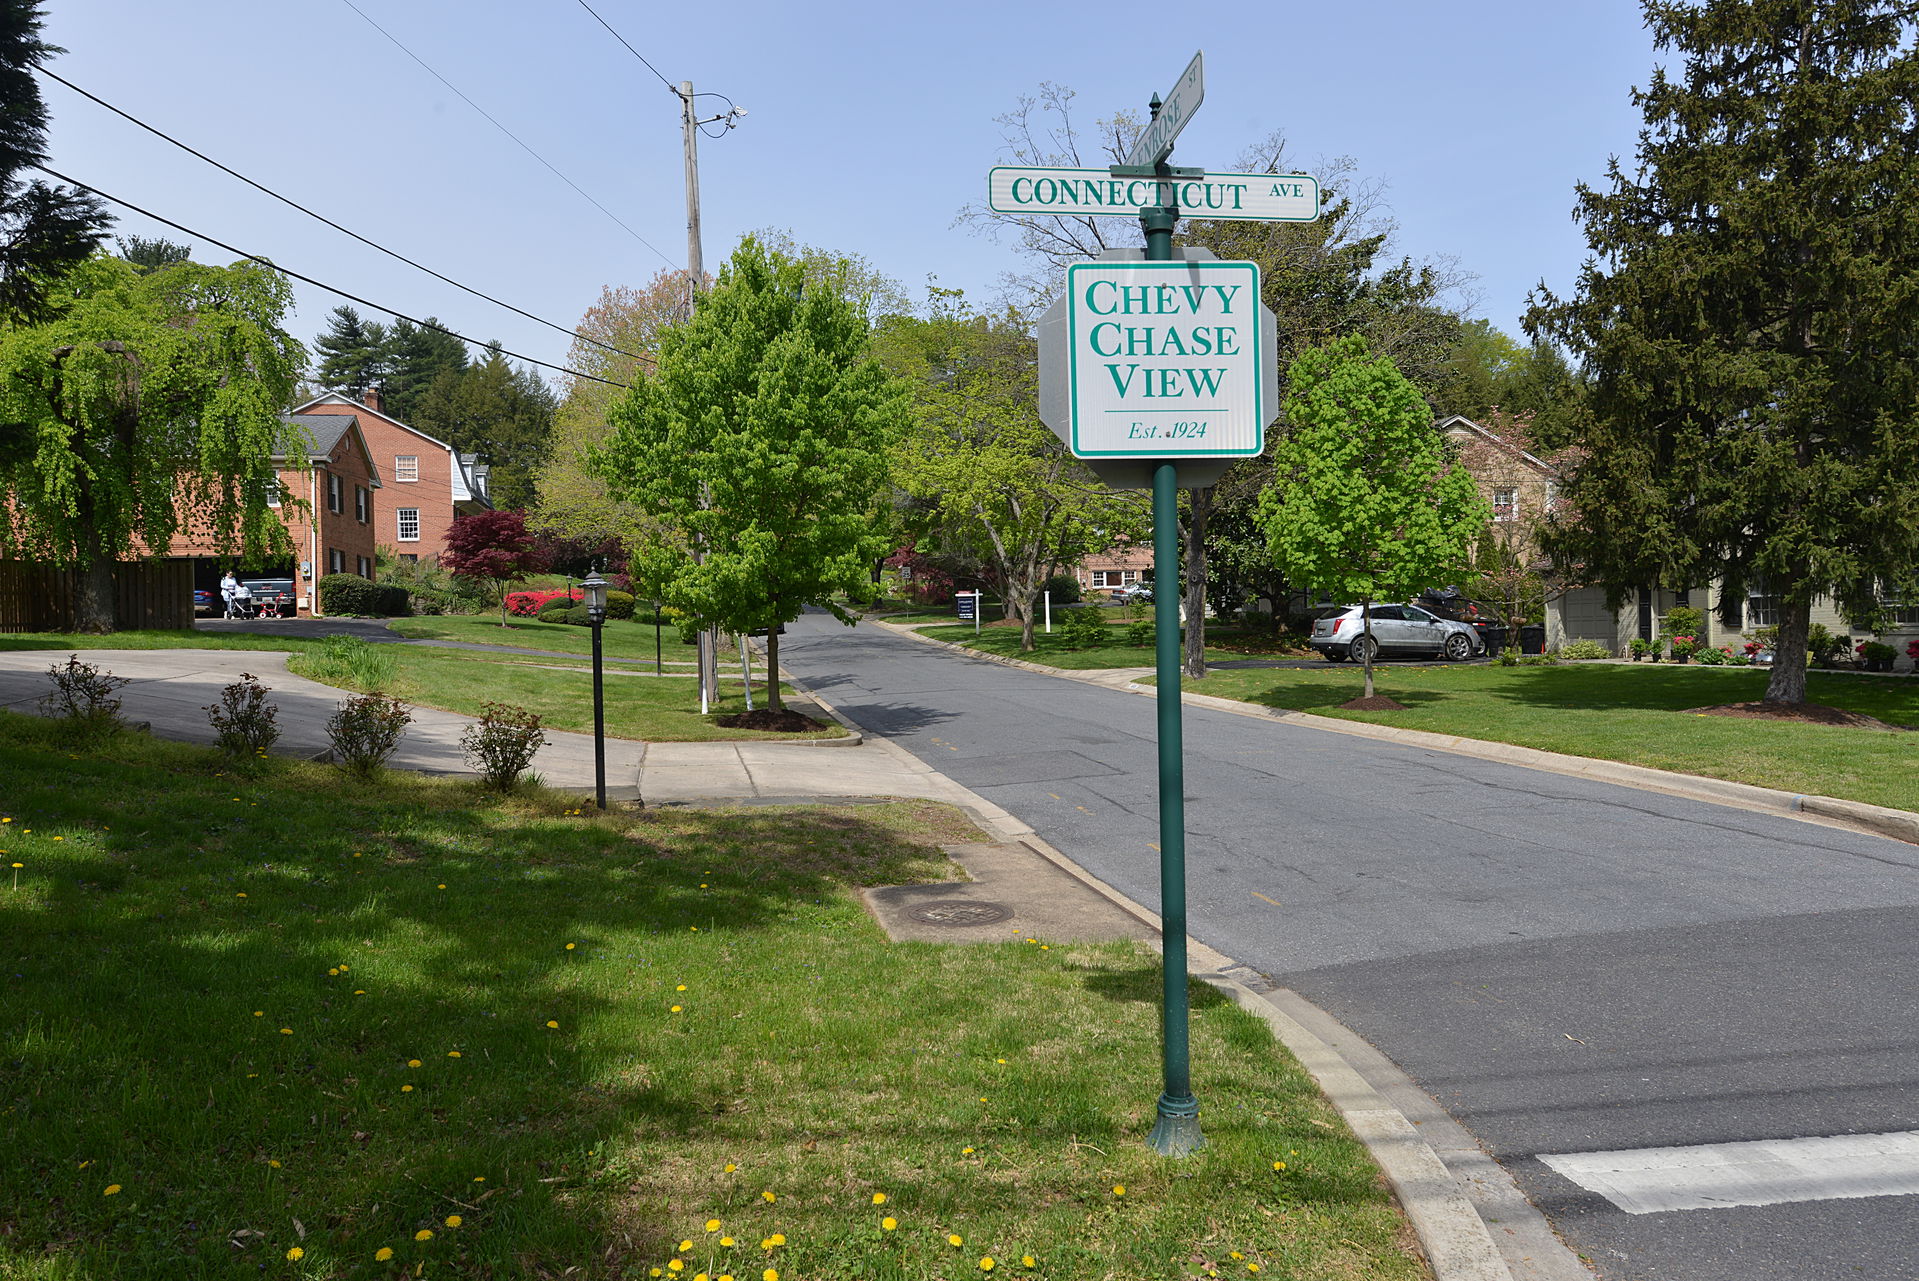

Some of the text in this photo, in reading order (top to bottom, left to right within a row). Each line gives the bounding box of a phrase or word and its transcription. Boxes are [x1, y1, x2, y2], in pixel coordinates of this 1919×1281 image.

[1188, 66, 1198, 88] ST
[1012, 177, 1304, 209] CONNECTICUT AVE
[1085, 281, 1242, 315] CHEVY
[1090, 322, 1240, 356] CHASE
[1104, 364, 1228, 398] VIEW
[1128, 422, 1207, 439] Est. 1924
